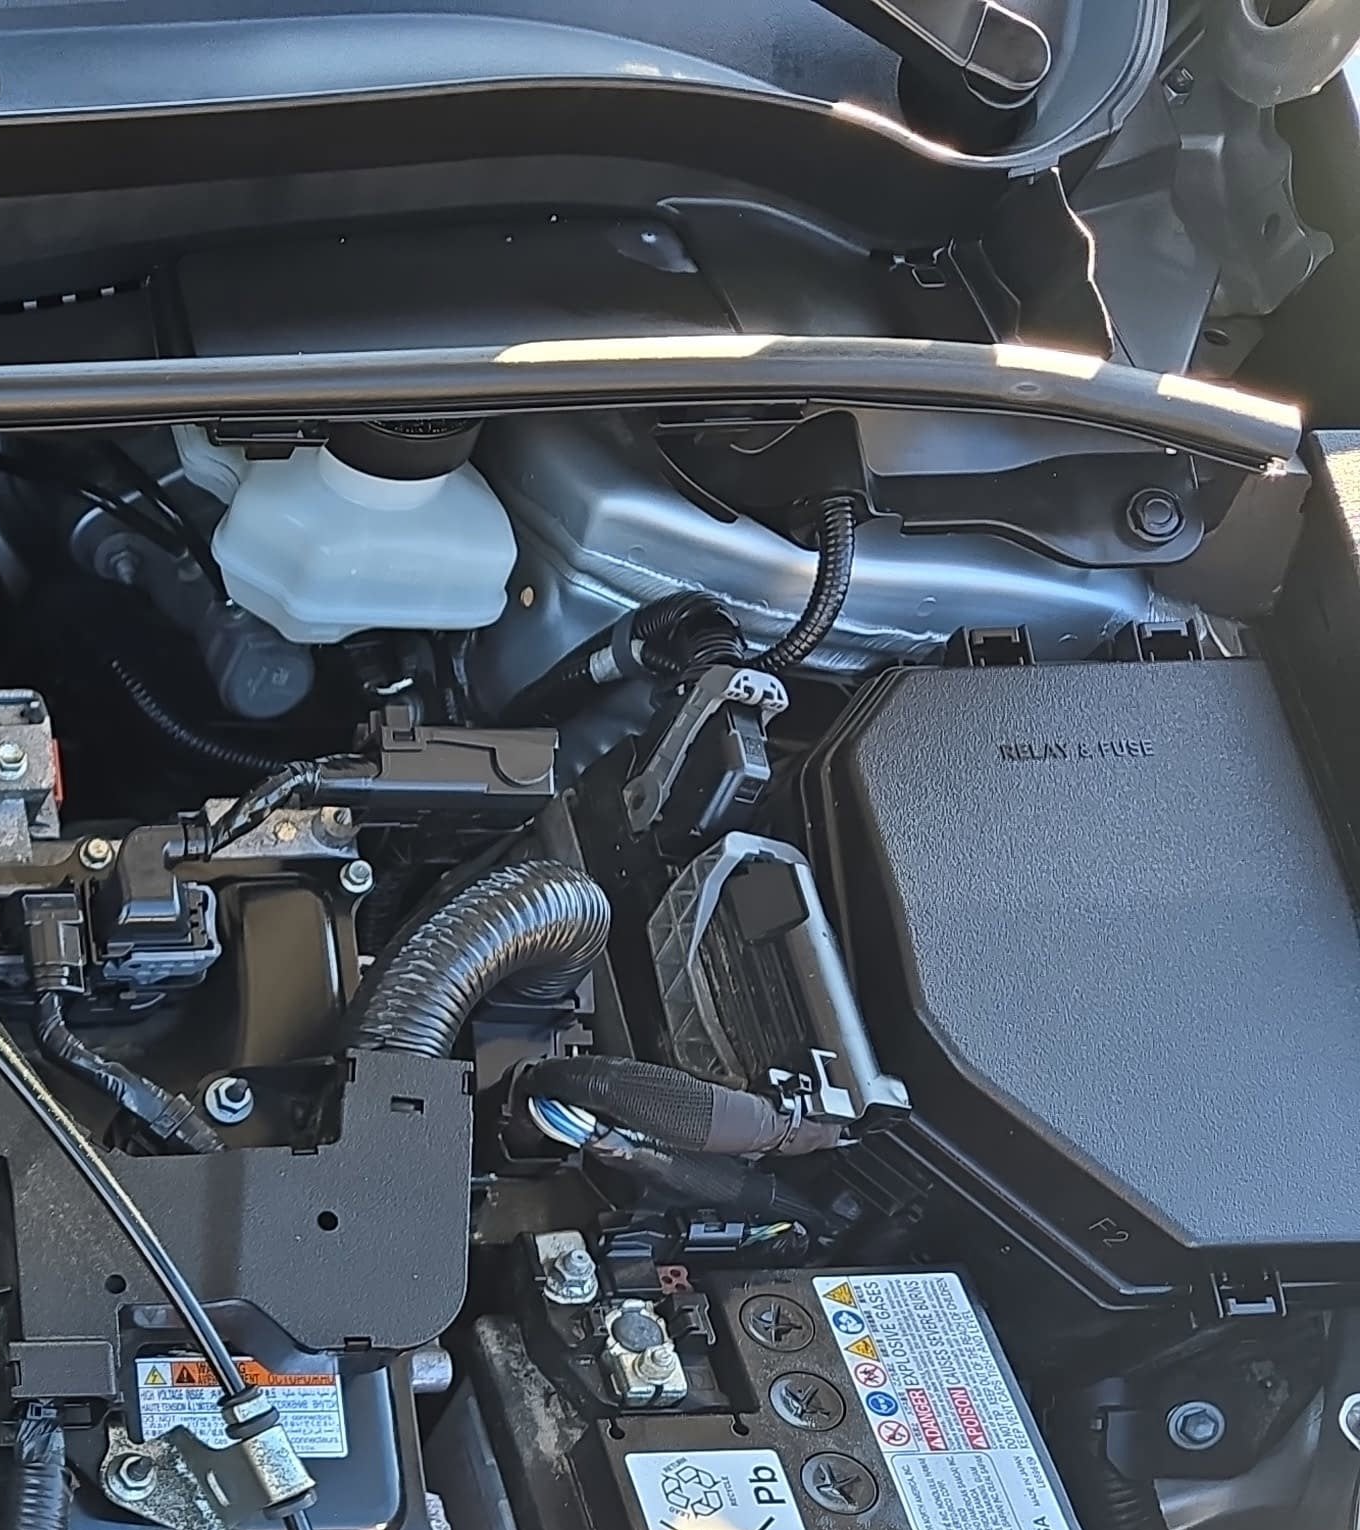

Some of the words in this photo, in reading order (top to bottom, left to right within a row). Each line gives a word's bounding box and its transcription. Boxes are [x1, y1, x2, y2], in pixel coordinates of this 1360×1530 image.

[999, 743, 1068, 762] RELAY
[1079, 741, 1094, 760] &
[1098, 739, 1155, 758] FUSE
[1088, 1217, 1129, 1248] F2
[862, 1281, 892, 1319] GASES
[903, 1280, 930, 1309] BURNS
[934, 1277, 958, 1310] CHILDREN
[949, 1311, 962, 1320] OF
[959, 1310, 980, 1333] LEVEL
[917, 1313, 945, 1346] SEVERE
[953, 1321, 973, 1344] REACH
[879, 1323, 919, 1385] EXPLOSIVE
[964, 1346, 979, 1359] THE
[971, 1335, 988, 1352] AND
[932, 1348, 962, 1384] CAUSES
[970, 1360, 984, 1370] OF
[979, 1354, 999, 1377] TIGHT
[975, 1372, 990, 1385] OUT
[158, 1389, 184, 1401] VOLTAGE
[981, 1387, 999, 1404] KEEP
[990, 1380, 1010, 1402] CAPS
[907, 1390, 940, 1435] DANGER
[949, 1389, 983, 1433] POISON
[1001, 1404, 1020, 1425] VENT
[996, 1422, 1013, 1436] NOT
[1011, 1427, 1030, 1448] KEEP
[1003, 1438, 1018, 1449] DO
[663, 1457, 688, 1474] RETURN
[1012, 1455, 1028, 1476] JAPAN
[720, 1475, 739, 1508] RECYCLE
[749, 1466, 786, 1505] Pb
[1025, 1487, 1041, 1506] MADE
[668, 1506, 691, 1520] LEAD
